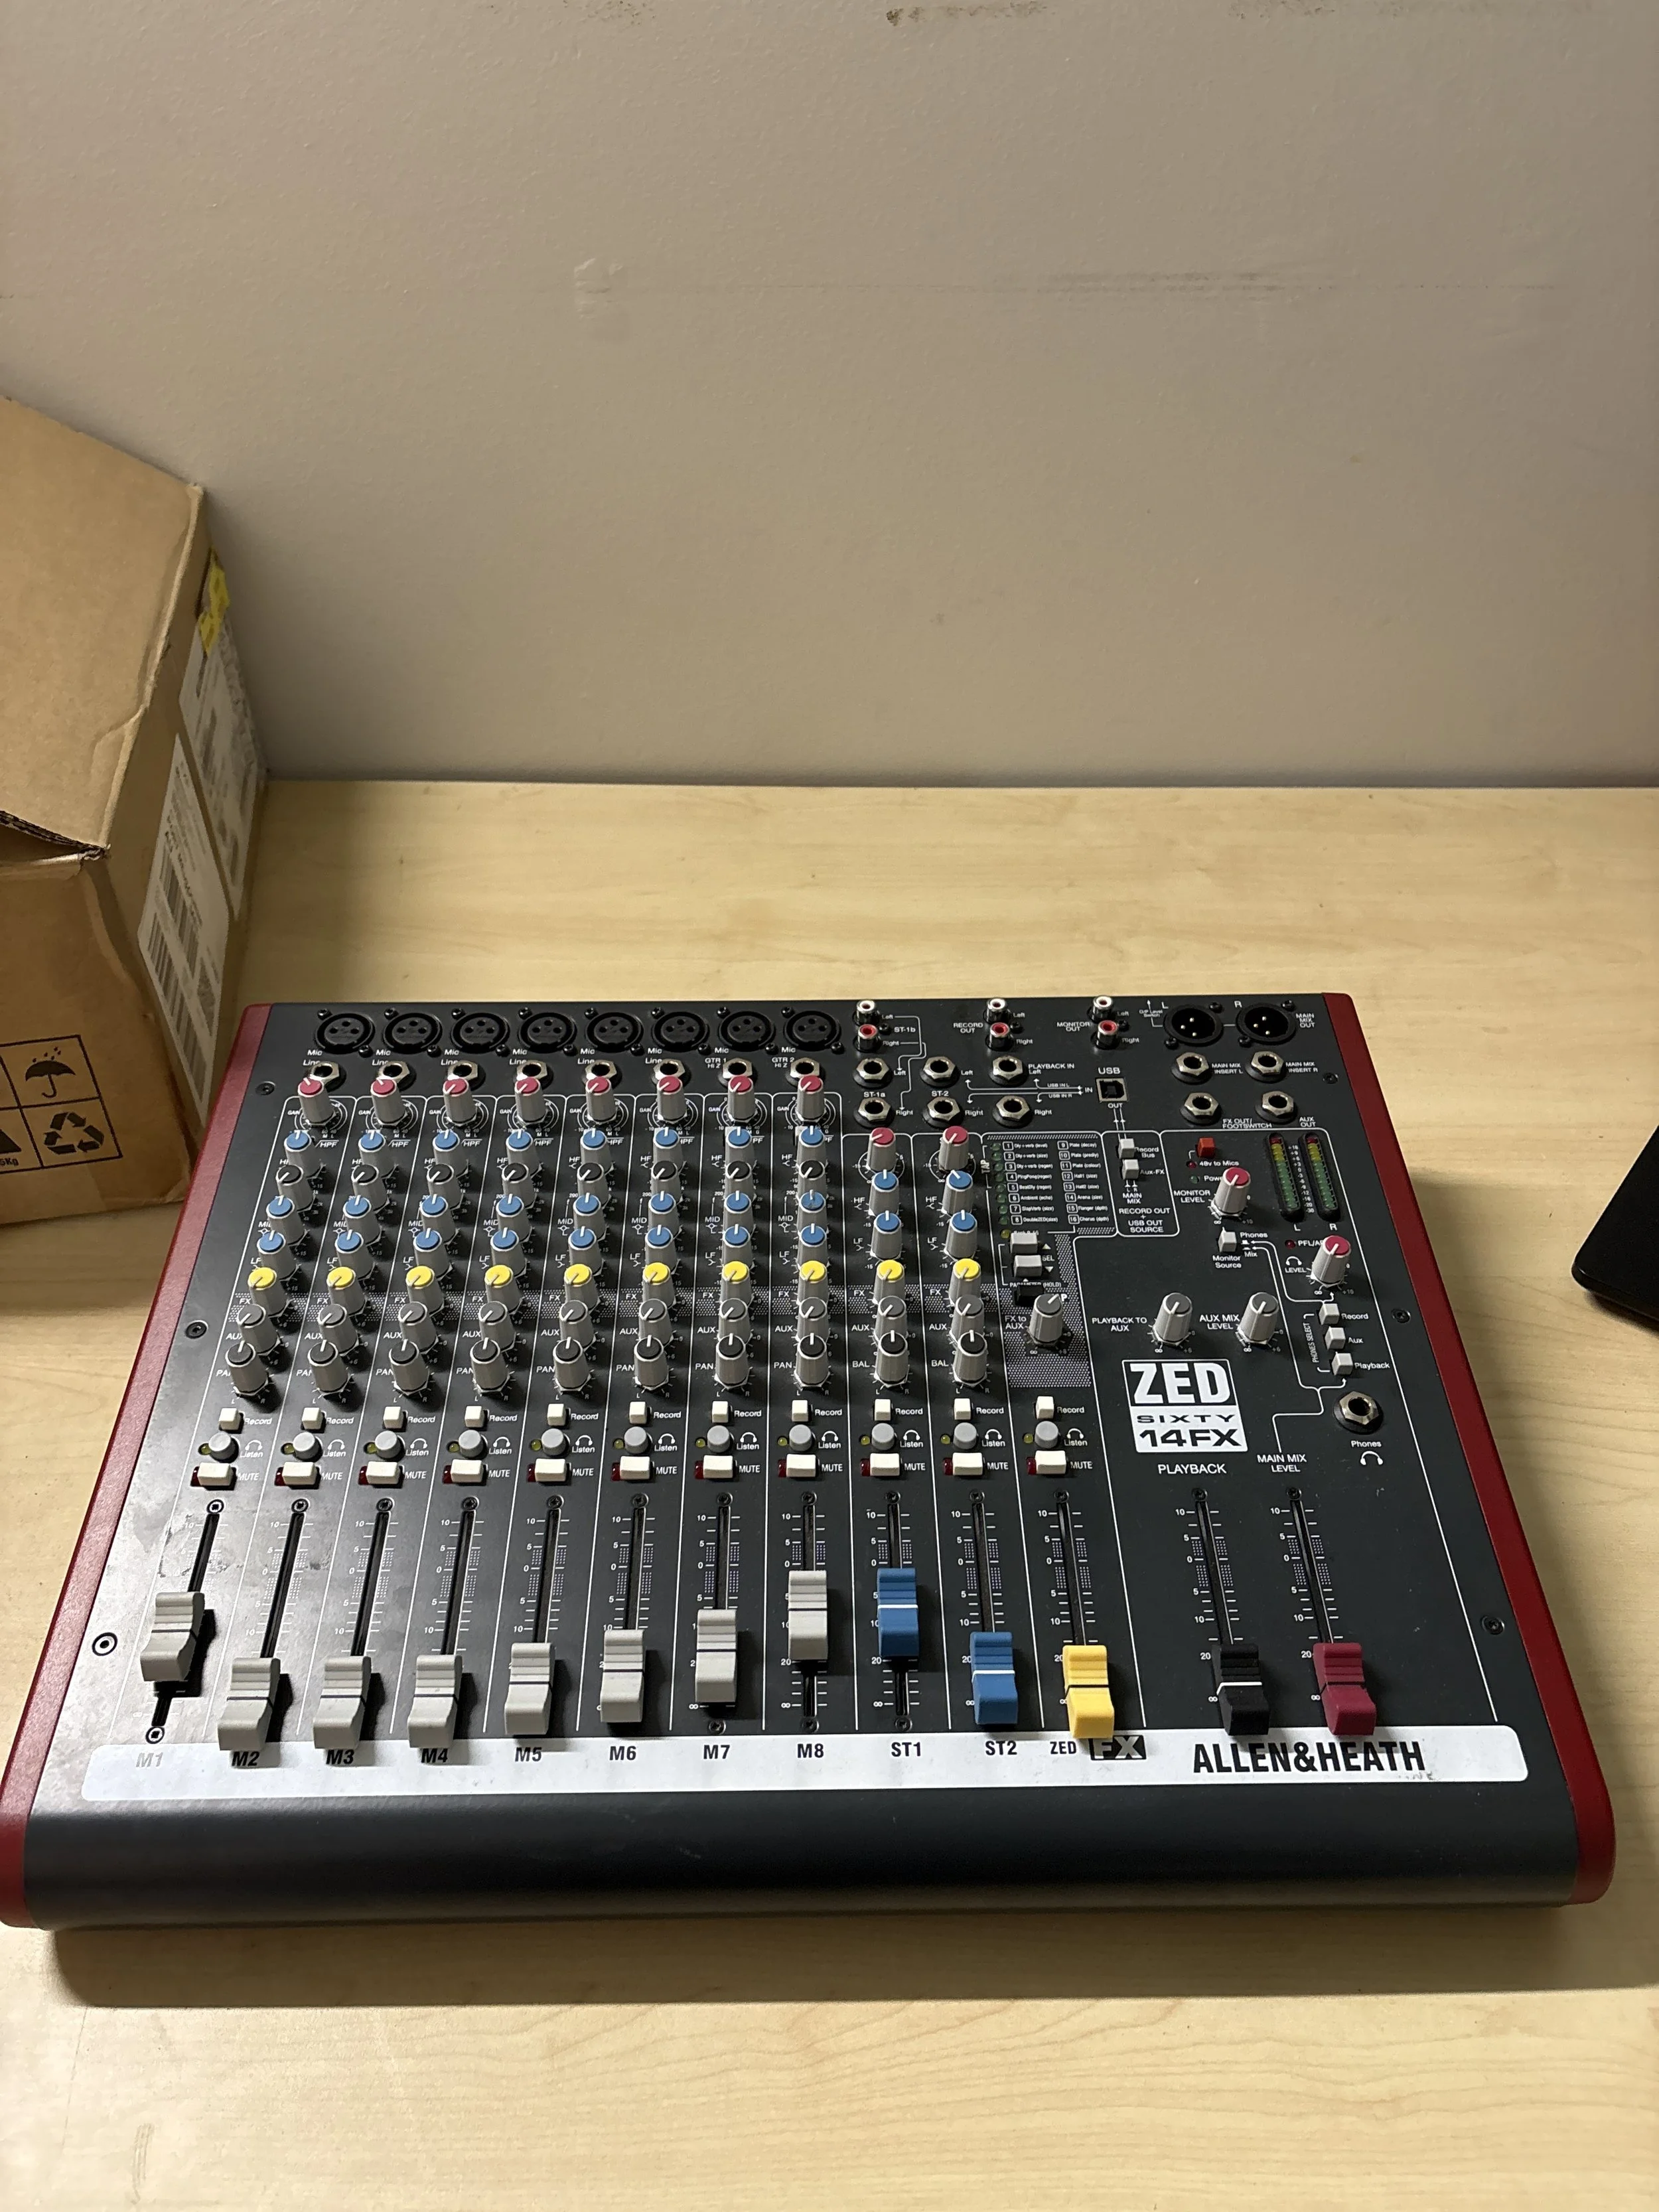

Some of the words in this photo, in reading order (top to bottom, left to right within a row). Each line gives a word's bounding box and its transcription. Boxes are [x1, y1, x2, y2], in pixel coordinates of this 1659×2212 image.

[778, 1290, 790, 1298] FX
[1199, 1314, 1220, 1323] AUX
[1303, 1323, 1313, 1341] SELECT
[1309, 1341, 1319, 1363] PHONES
[1129, 1363, 1232, 1404] ZED
[900, 1439, 924, 1448] Listen
[1139, 1429, 1242, 1447] 14FX
[571, 1445, 595, 1453] Listen
[654, 1443, 678, 1451] Listen
[1070, 1461, 1093, 1469] MUTE
[1257, 1454, 1285, 1463] MAIN
[572, 1467, 593, 1476] MUTE
[739, 1465, 760, 1473] MUTE
[1158, 1464, 1226, 1474] PLAYBACK
[1271, 1464, 1301, 1473] LEVEL
[1200, 1652, 1211, 1660] 20
[1301, 1650, 1313, 1659] 20
[515, 1745, 543, 1761] M5
[610, 1746, 636, 1760] M6
[703, 1745, 730, 1759] M7
[798, 1743, 824, 1758] M8
[892, 1742, 920, 1757] ST1
[985, 1739, 1018, 1755] ST2
[1050, 1740, 1078, 1754] ZED
[136, 1752, 163, 1767] M1
[232, 1751, 260, 1767] M2
[326, 1749, 355, 1765] M3
[421, 1748, 448, 1763] M4
[1194, 1739, 1425, 1773] ALLEN&HEATH
